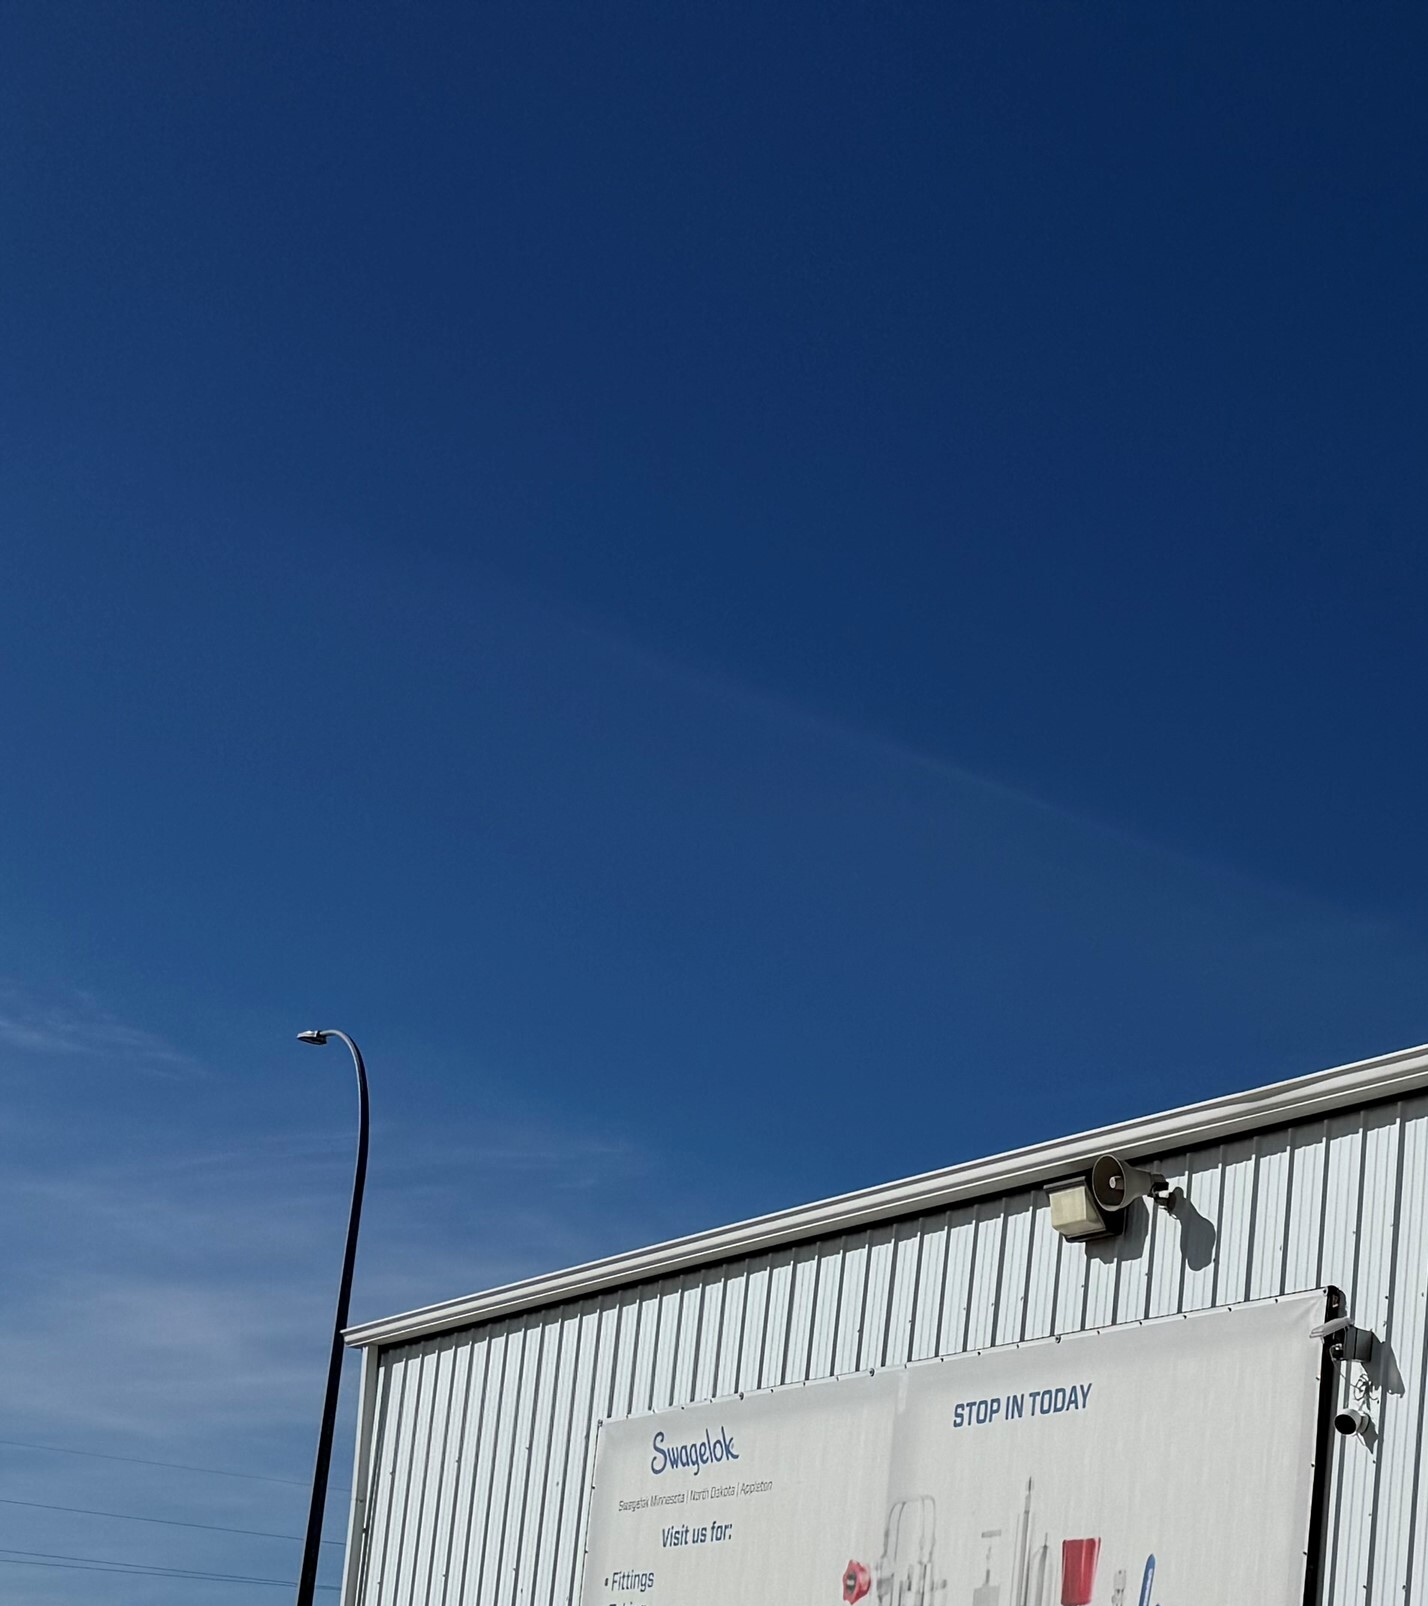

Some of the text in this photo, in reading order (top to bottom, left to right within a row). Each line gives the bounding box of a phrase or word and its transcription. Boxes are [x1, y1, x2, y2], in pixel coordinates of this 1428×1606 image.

[953, 1383, 1092, 1428] STOP IN TODAY
[651, 1426, 739, 1476] Swagelok
[650, 1493, 685, 1508] Minnesota
[690, 1488, 709, 1501] North
[710, 1485, 735, 1499] Dakota
[740, 1480, 773, 1496] Appleton
[662, 1521, 733, 1548] Visit us for:
[611, 1571, 655, 1592] Fittings
